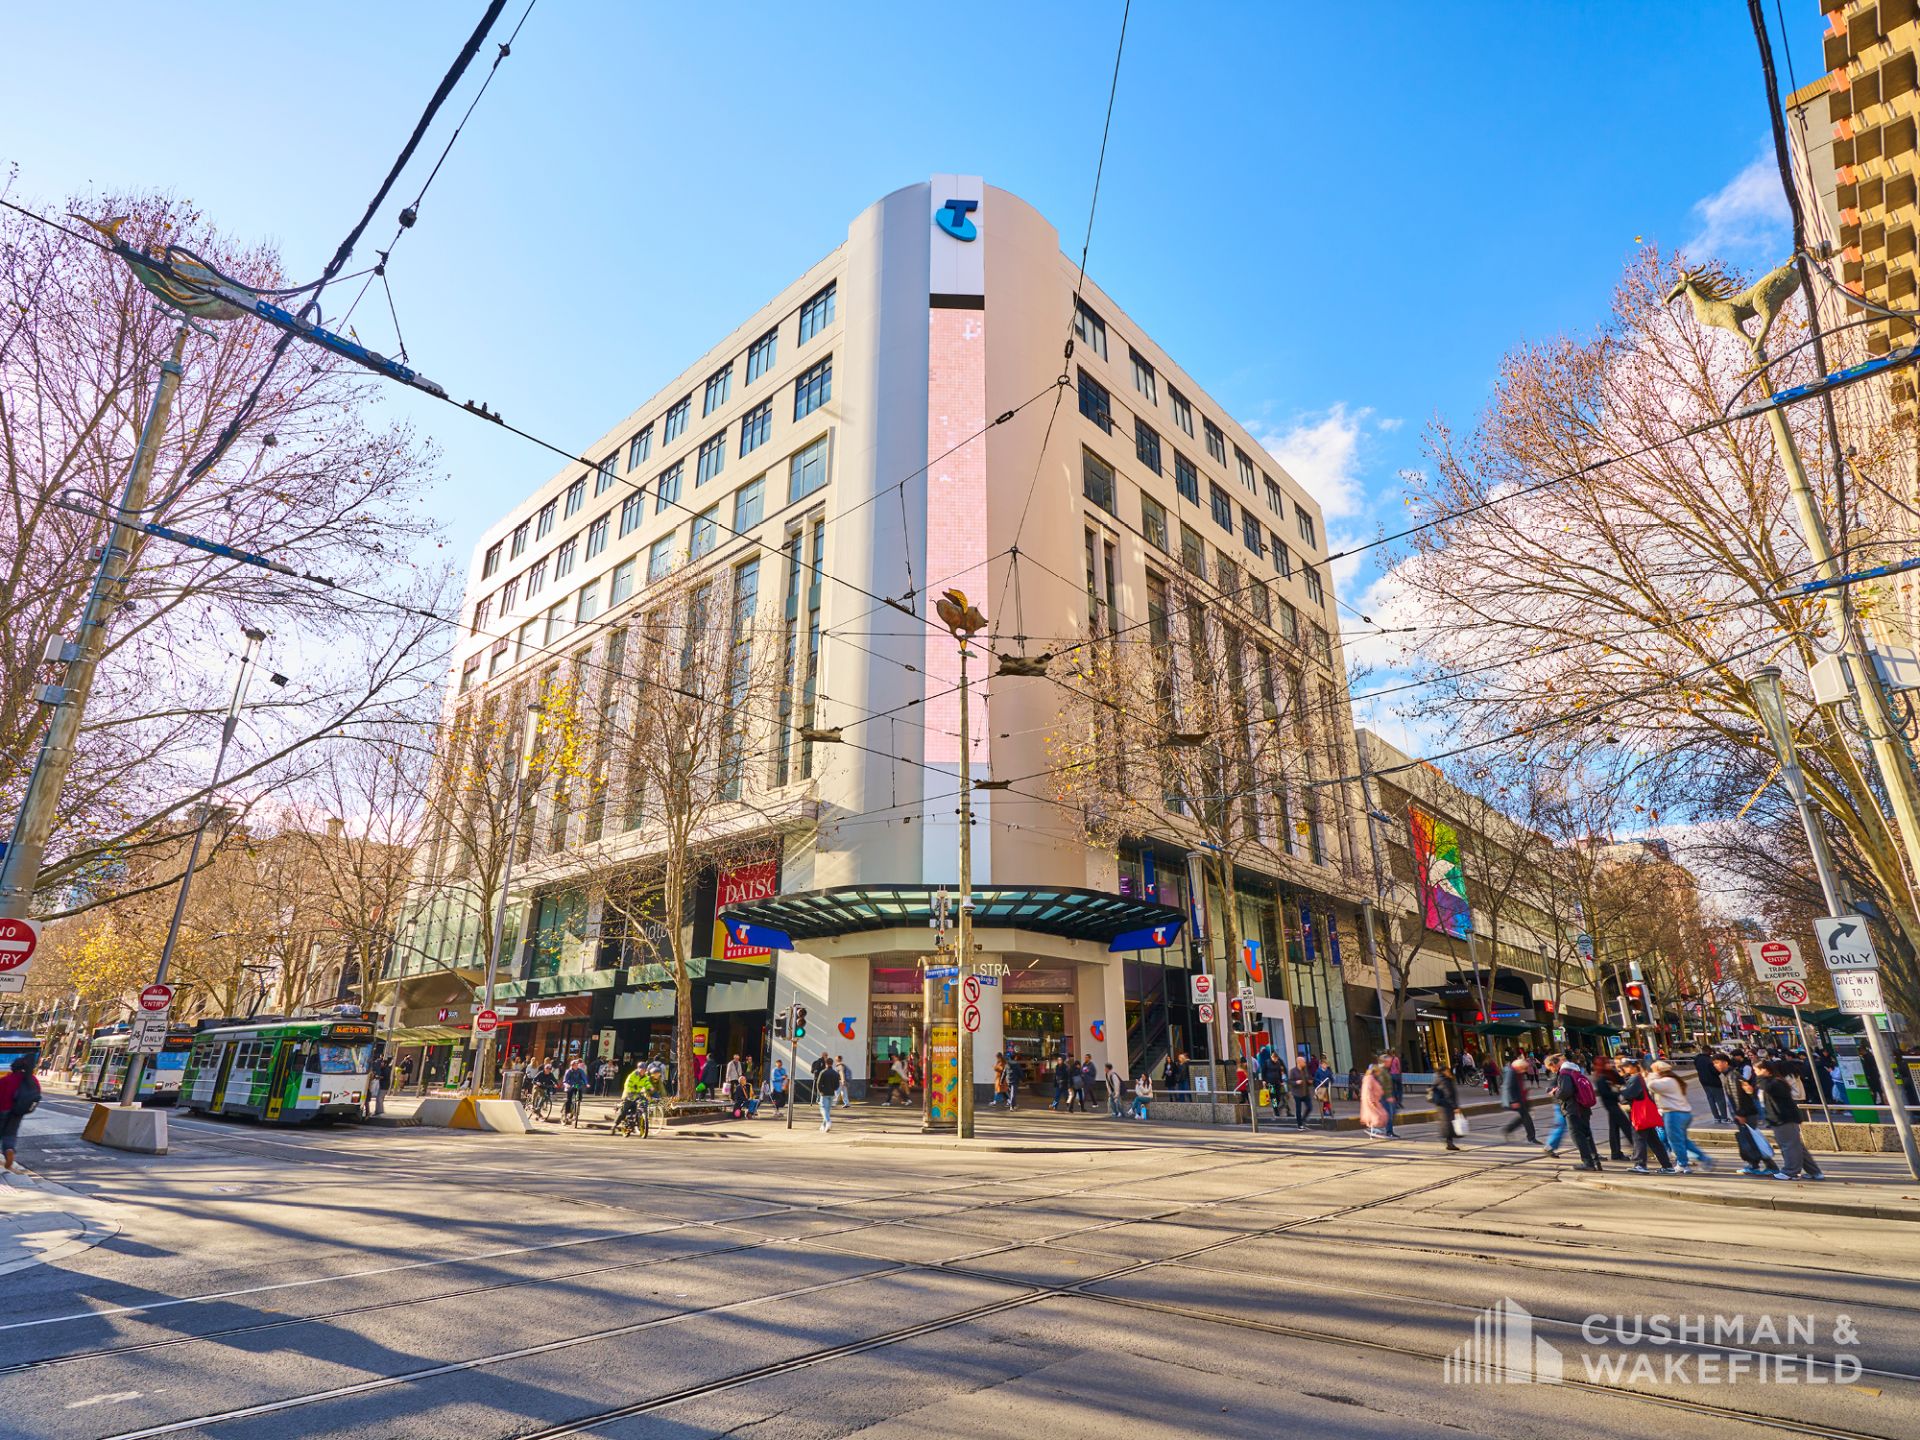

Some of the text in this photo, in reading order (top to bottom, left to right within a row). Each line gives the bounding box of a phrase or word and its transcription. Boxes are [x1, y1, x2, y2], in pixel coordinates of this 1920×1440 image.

[1829, 953, 1870, 965] ONLY
[1764, 971, 1800, 979] EXCEPTED
[1835, 976, 1874, 985] GIVE WAY
[1852, 988, 1862, 997] TO
[1841, 999, 1880, 1009] PEDESTRIANS
[144, 1035, 163, 1043] ONLY
